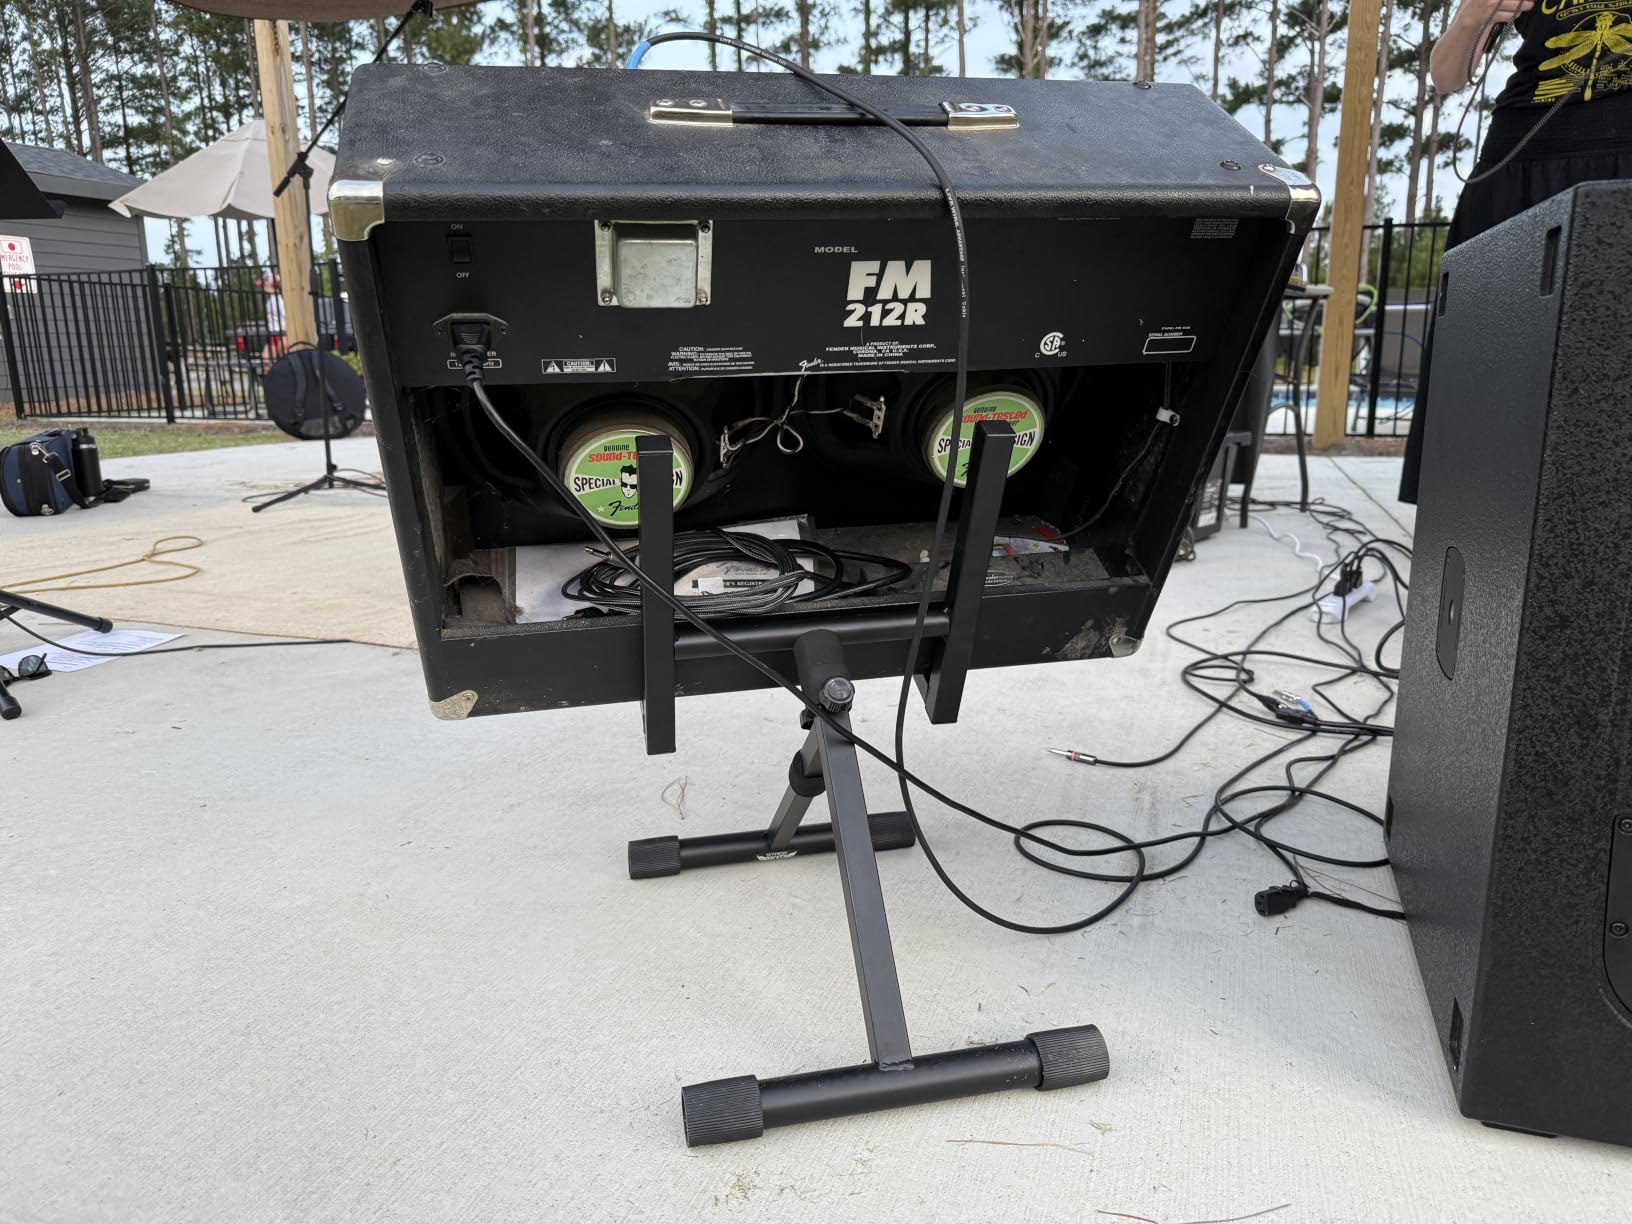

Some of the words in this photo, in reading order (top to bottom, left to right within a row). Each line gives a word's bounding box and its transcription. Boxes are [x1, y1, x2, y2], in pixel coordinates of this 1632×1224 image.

[0, 253, 29, 263] MERGENCY
[814, 246, 859, 254] MODEL
[455, 271, 471, 279] OFF
[846, 260, 932, 301] FM
[843, 302, 927, 328] 212R
[603, 444, 630, 452] genuine
[937, 438, 972, 454] SPCIA
[573, 476, 617, 493] SPECIAL
[608, 500, 638, 517] Fend
